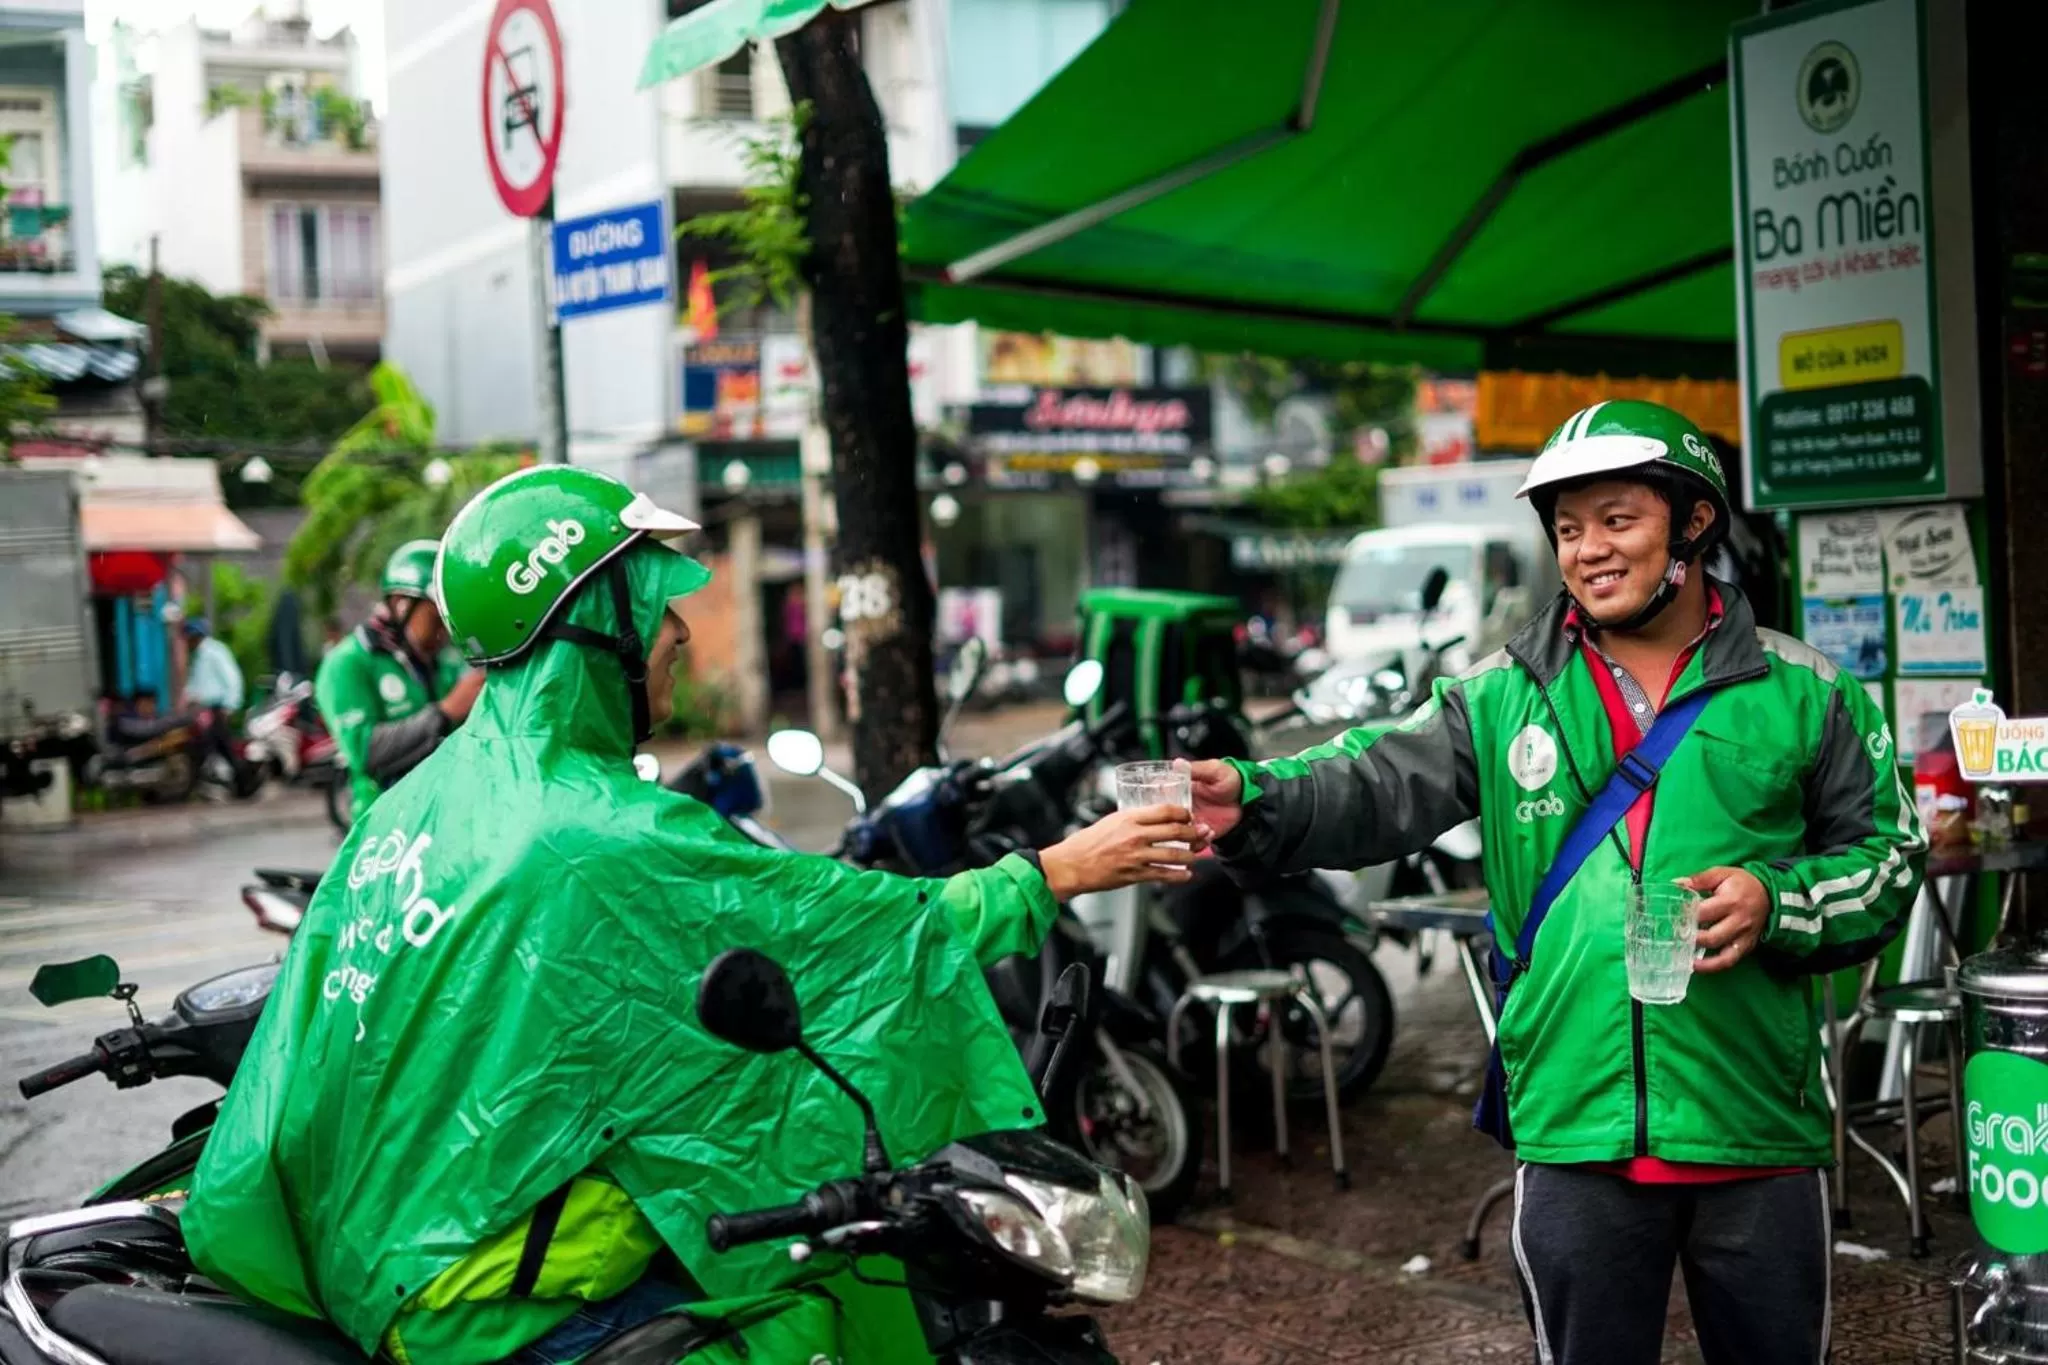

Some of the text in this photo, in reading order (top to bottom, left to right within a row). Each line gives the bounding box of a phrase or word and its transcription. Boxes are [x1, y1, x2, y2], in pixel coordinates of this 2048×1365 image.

[1836, 132, 1893, 176] Cuốn
[1753, 175, 1921, 261] Ba Miền
[506, 519, 586, 594] Grab
[1516, 791, 1564, 823] Grab
[1968, 1149, 2048, 1209] Foo
